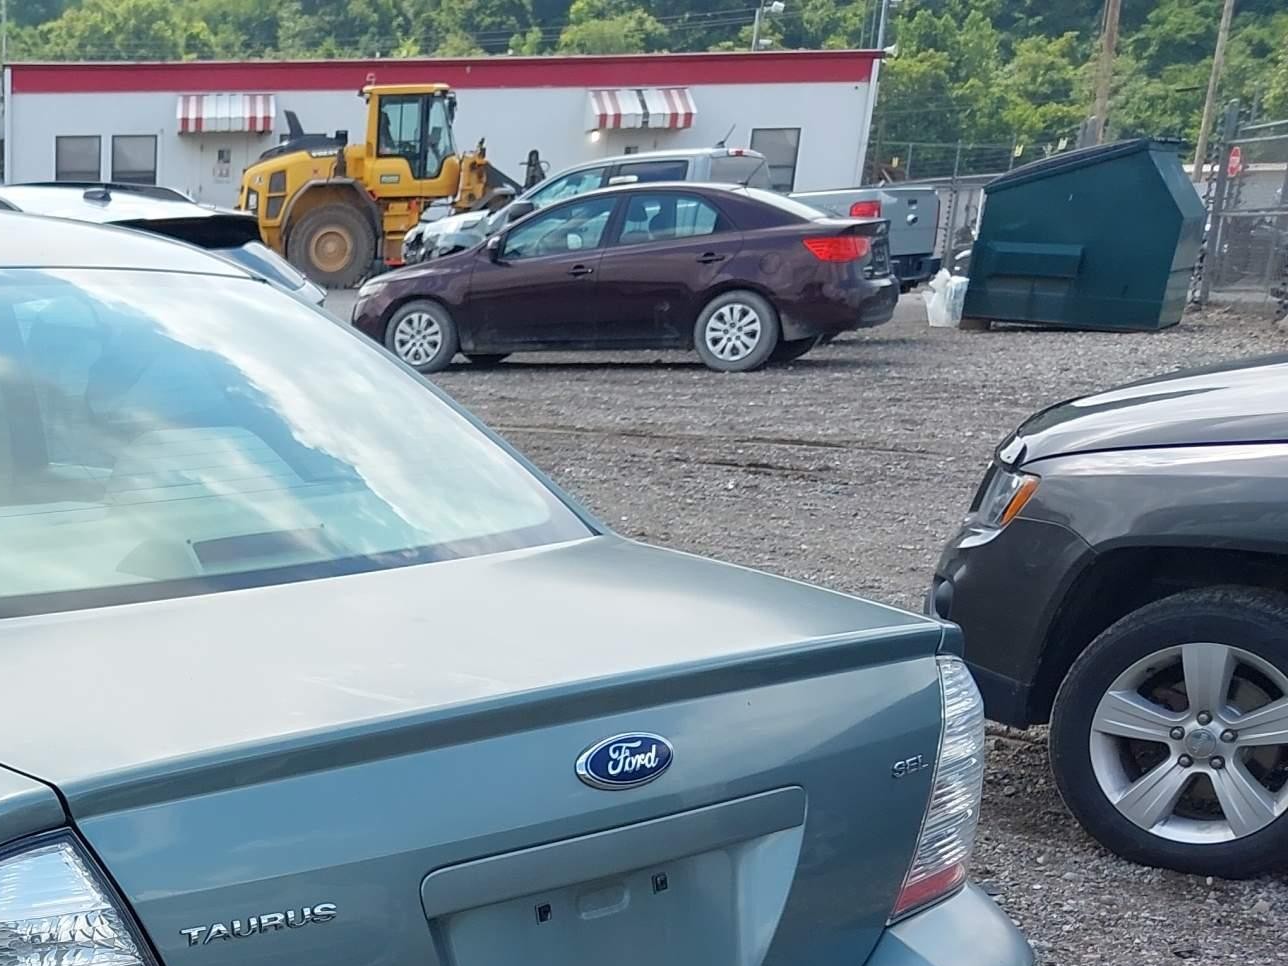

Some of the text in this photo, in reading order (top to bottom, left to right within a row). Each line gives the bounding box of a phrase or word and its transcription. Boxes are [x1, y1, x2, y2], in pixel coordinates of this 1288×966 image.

[608, 740, 659, 775] Ford
[893, 755, 929, 777] SEL
[180, 903, 337, 946] TAURUS
